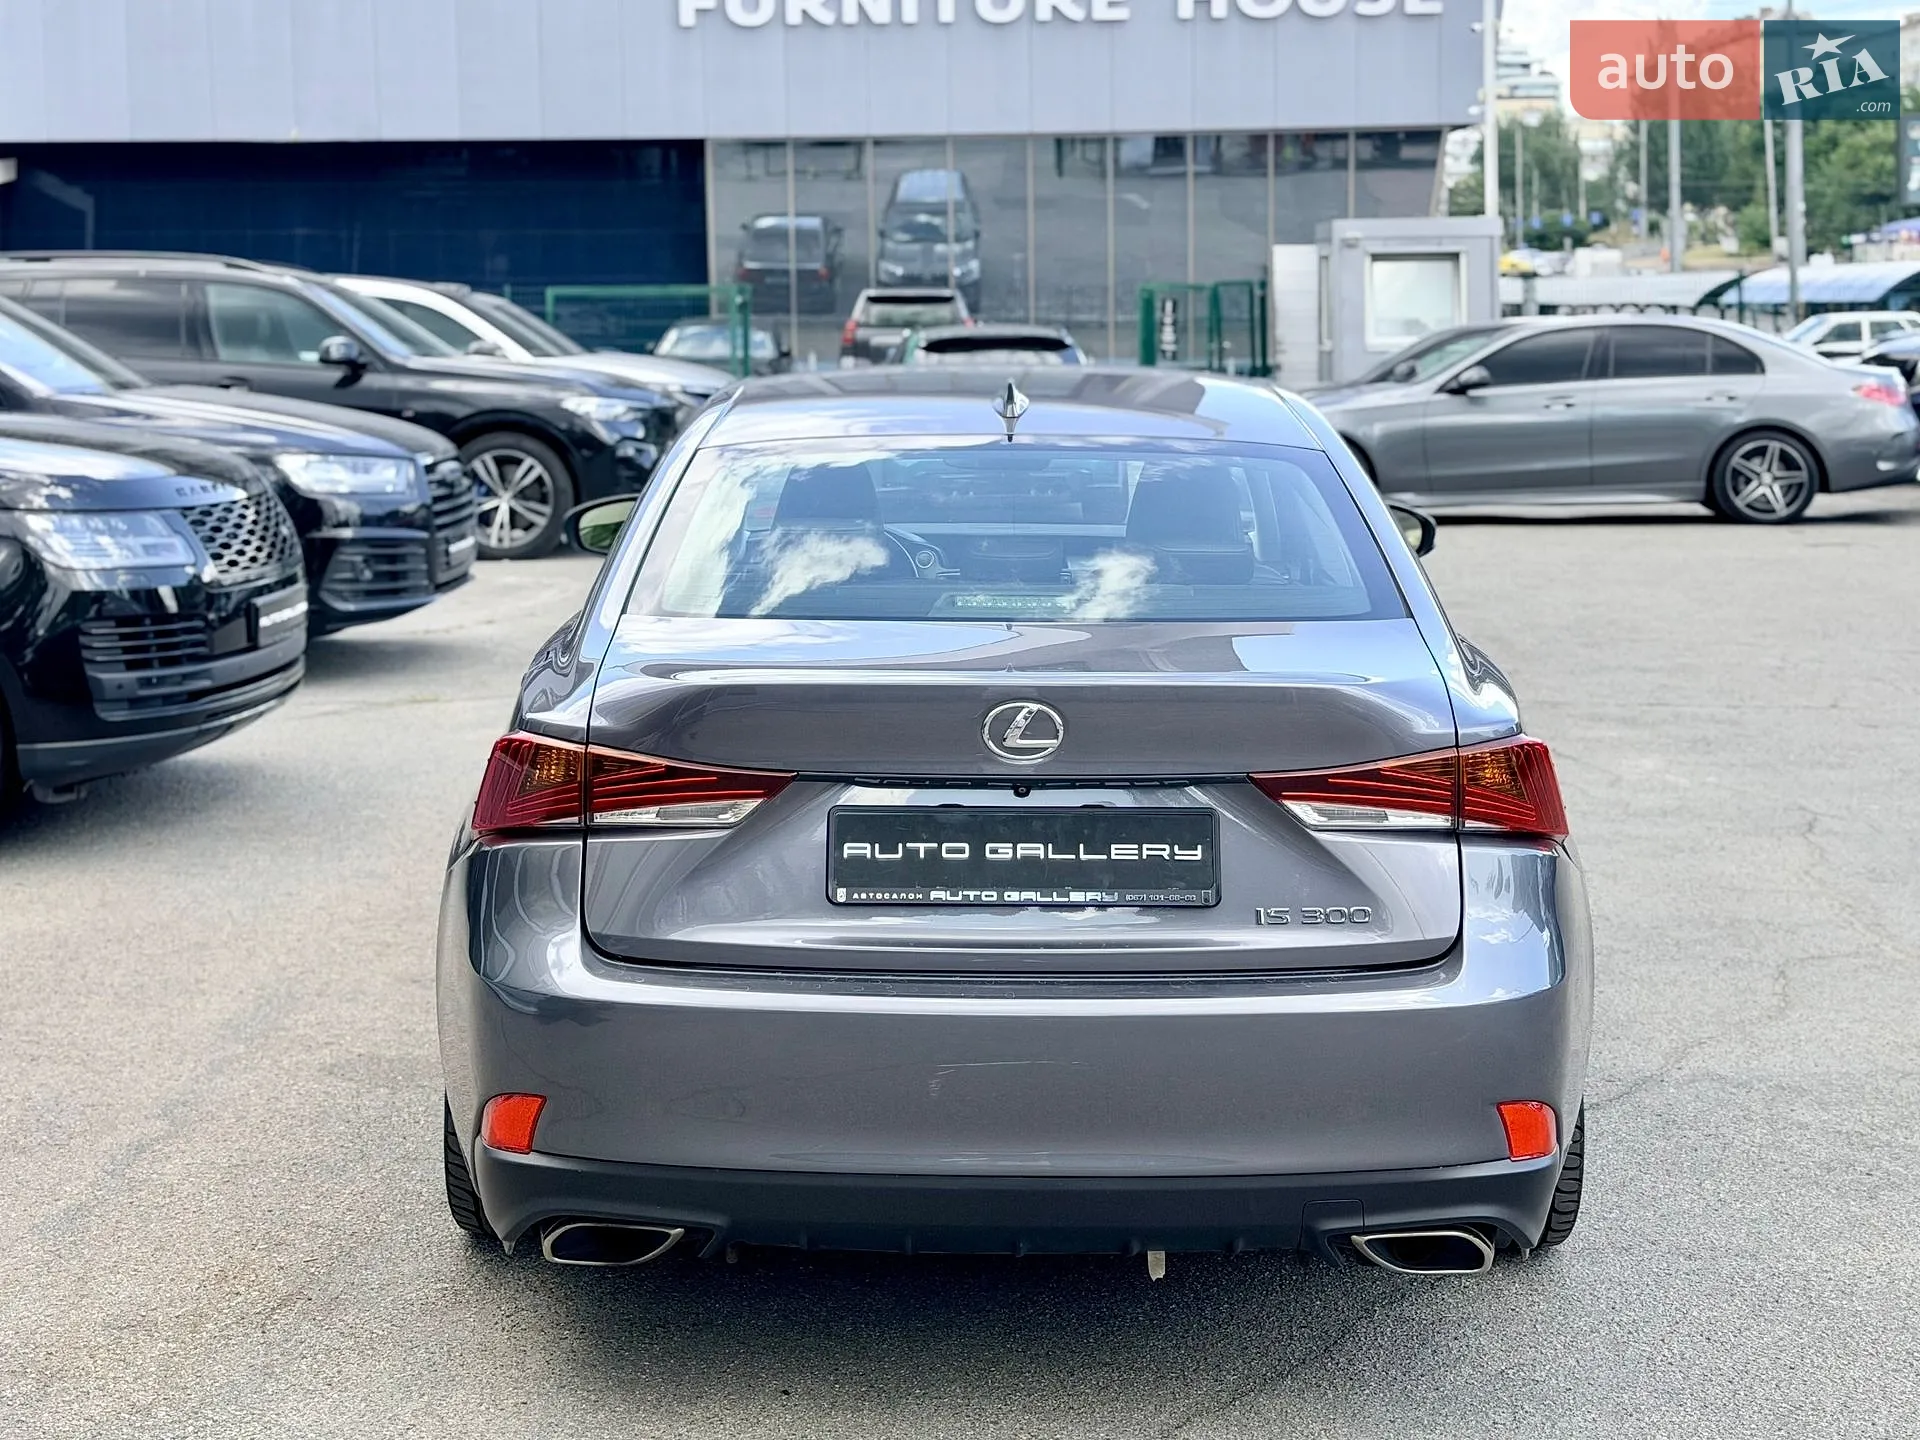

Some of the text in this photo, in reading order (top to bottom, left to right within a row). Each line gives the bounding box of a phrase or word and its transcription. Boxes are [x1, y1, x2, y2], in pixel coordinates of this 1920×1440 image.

[843, 842, 1203, 861] AUTO GALLERY
[930, 890, 998, 902] AUTO
[1003, 891, 1118, 902] GALLERY
[1255, 906, 1372, 925] IS 300
